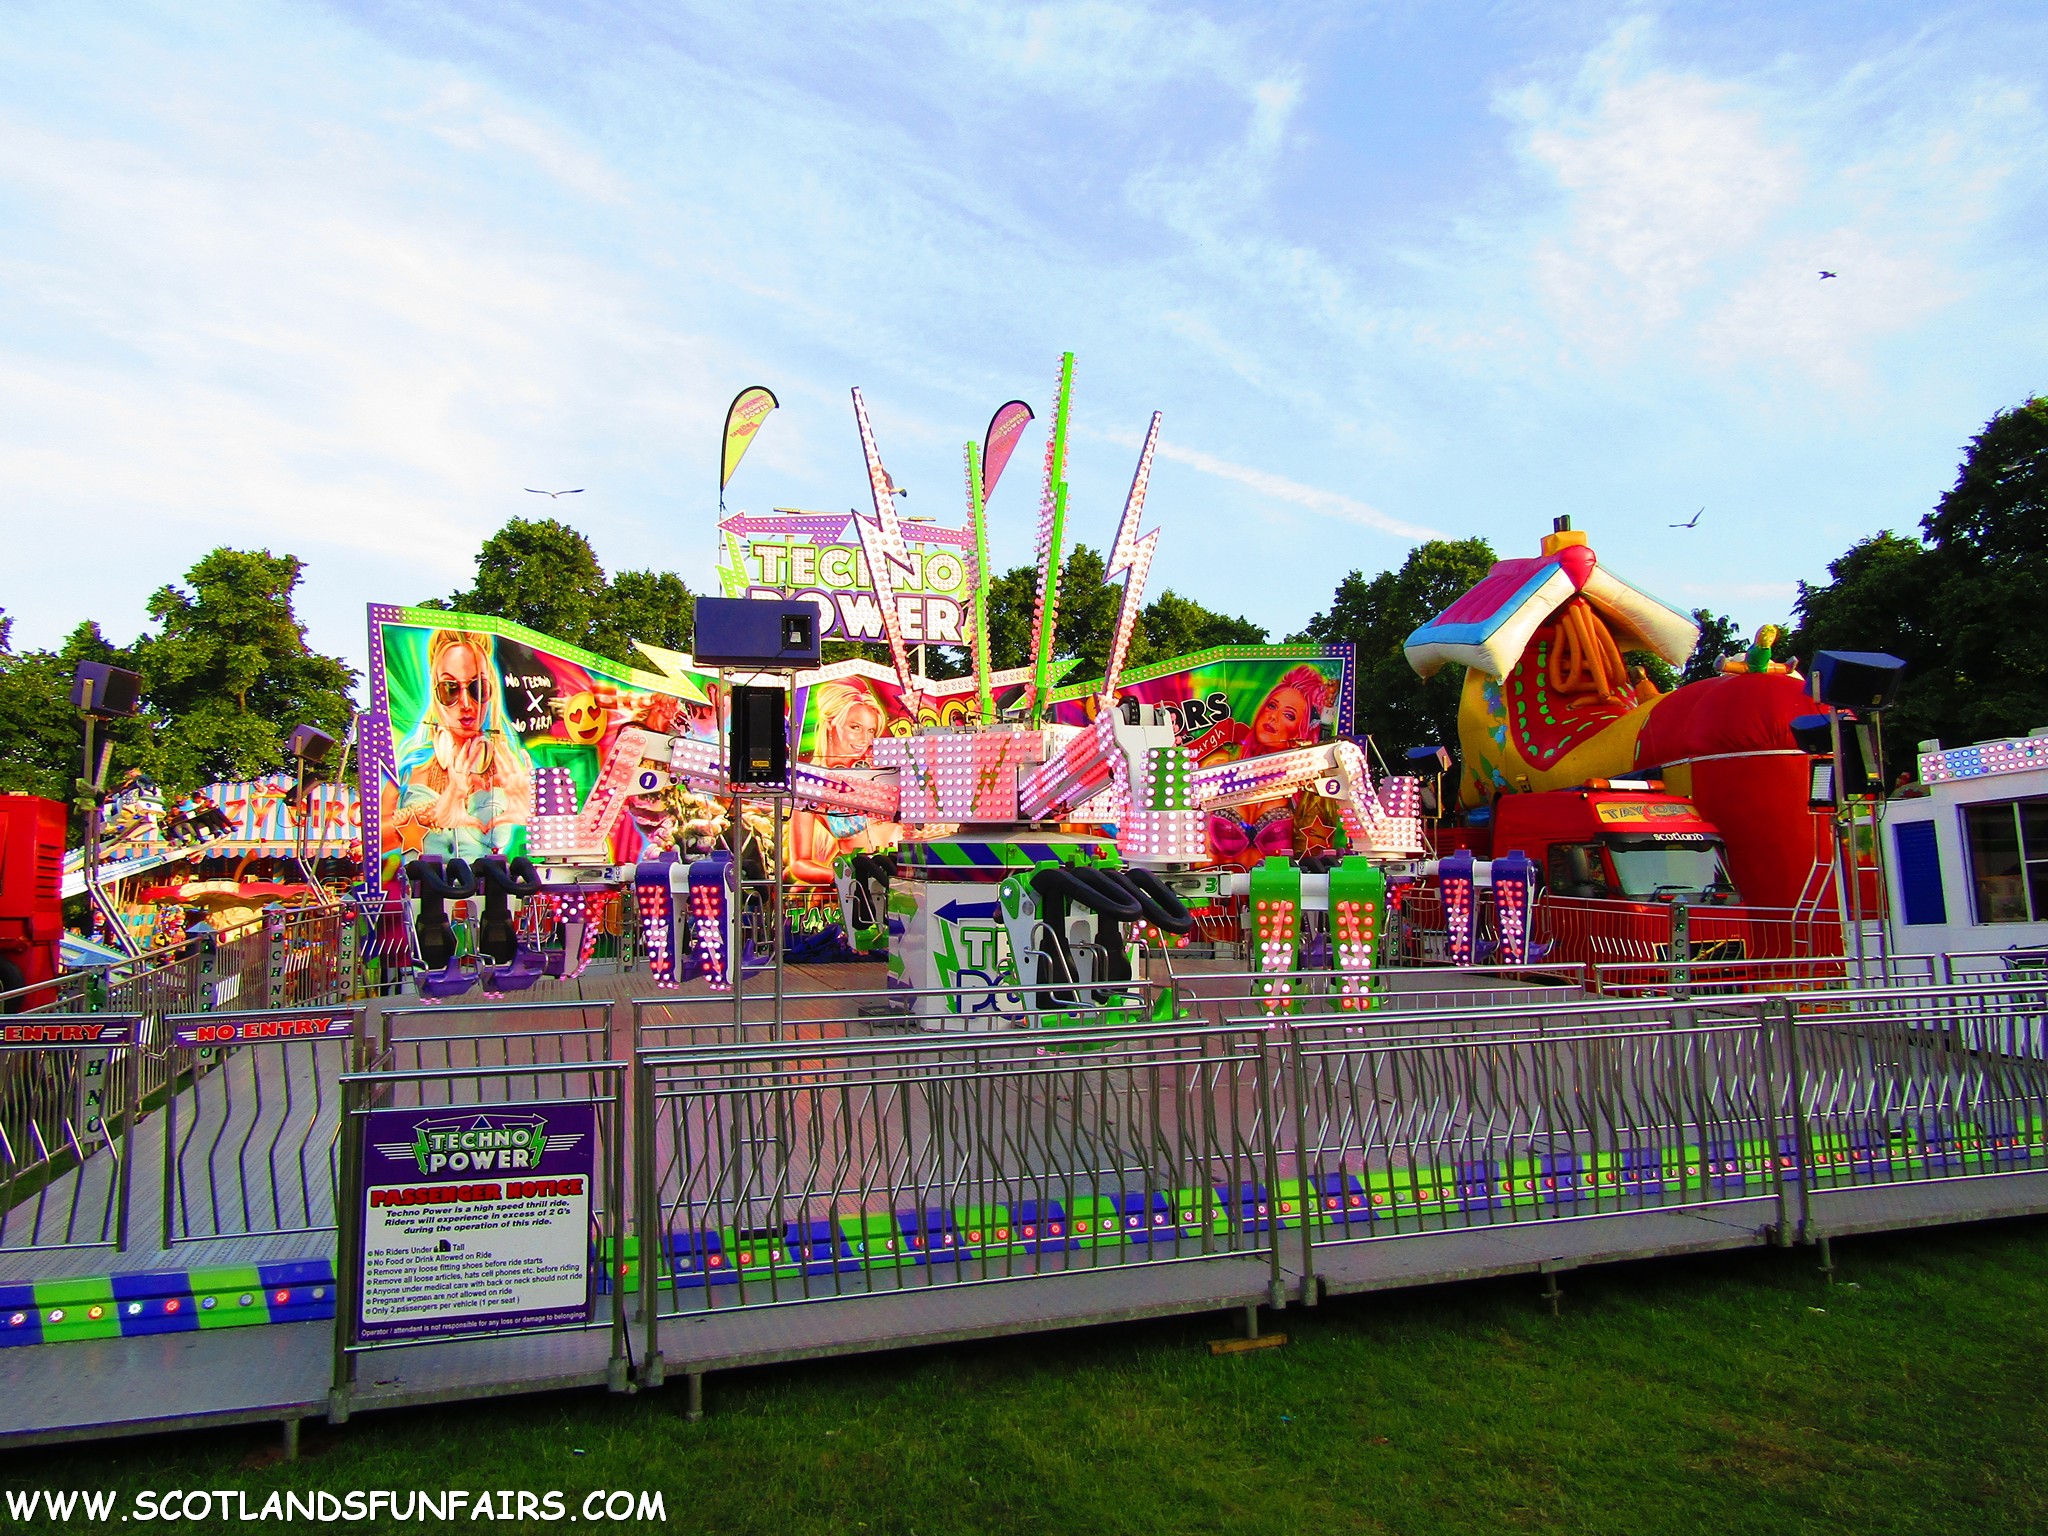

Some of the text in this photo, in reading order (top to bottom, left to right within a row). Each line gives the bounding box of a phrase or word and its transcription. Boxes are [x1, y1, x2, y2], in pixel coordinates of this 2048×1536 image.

[744, 404, 769, 420] POWER
[1002, 418, 1025, 435] POWER
[750, 589, 963, 642] OWER
[504, 672, 520, 688] NO
[526, 689, 544, 713] X
[511, 718, 527, 733] NO
[644, 775, 653, 787] 1
[1328, 781, 1338, 793] 3
[1601, 803, 1688, 820] TAYLORS
[604, 868, 613, 879] 2
[1205, 877, 1217, 894] 3
[4, 1024, 105, 1042] ENTRY
[196, 1018, 332, 1042] NO ENTRY
[431, 1131, 530, 1150] TECHNO
[430, 1149, 530, 1173] POWER
[370, 1179, 584, 1207] PASSENGER NOTICE
[385, 1217, 415, 1226] Riders
[418, 1216, 435, 1224] will
[437, 1214, 488, 1224] experience
[502, 1211, 535, 1219] excess
[537, 1209, 547, 1217] of
[557, 1207, 571, 1215] G's
[386, 1208, 420, 1217] Techno
[422, 1207, 452, 1215] Power
[474, 1203, 493, 1213] high
[496, 1202, 524, 1212] speed
[404, 1226, 434, 1234] during
[454, 1221, 498, 1232] operation
[501, 1220, 511, 1228] of
[512, 1219, 530, 1227] this
[374, 1249, 384, 1257] No
[411, 1246, 432, 1254] Under
[415, 1255, 434, 1263] Drink
[435, 1253, 464, 1262] Allowed
[476, 1251, 492, 1259] Ride
[373, 1268, 402, 1276] Remove
[418, 1265, 438, 1273] loose
[440, 1264, 461, 1272] fitting
[462, 1262, 483, 1270] shoes
[485, 1260, 507, 1268] before
[523, 1257, 543, 1265] starts
[414, 1275, 434, 1283] loose
[435, 1273, 463, 1281] articles,
[464, 1271, 480, 1279] hats
[495, 1268, 521, 1278] phones
[536, 1265, 558, 1273] before
[560, 1264, 580, 1272] riding
[372, 1287, 401, 1296] Anyone
[424, 1282, 452, 1291] medical
[470, 1279, 485, 1288] with
[486, 1278, 503, 1287] back
[513, 1276, 530, 1284] neck
[532, 1274, 555, 1283] should
[372, 1296, 405, 1306] Pregnant
[459, 1289, 487, 1298] allowed
[499, 1287, 513, 1295] ride
[372, 1307, 389, 1315] Only
[396, 1302, 438, 1314] passengers
[439, 1302, 451, 1310] per
[453, 1300, 478, 1308] vehicle
[487, 1298, 499, 1307] per
[361, 1329, 389, 1337] Operator
[393, 1325, 423, 1334] attendant
[442, 1321, 478, 1330] responsible
[478, 1319, 488, 1327] for
[522, 1316, 546, 1324] damage
[554, 1311, 586, 1320] belongings
